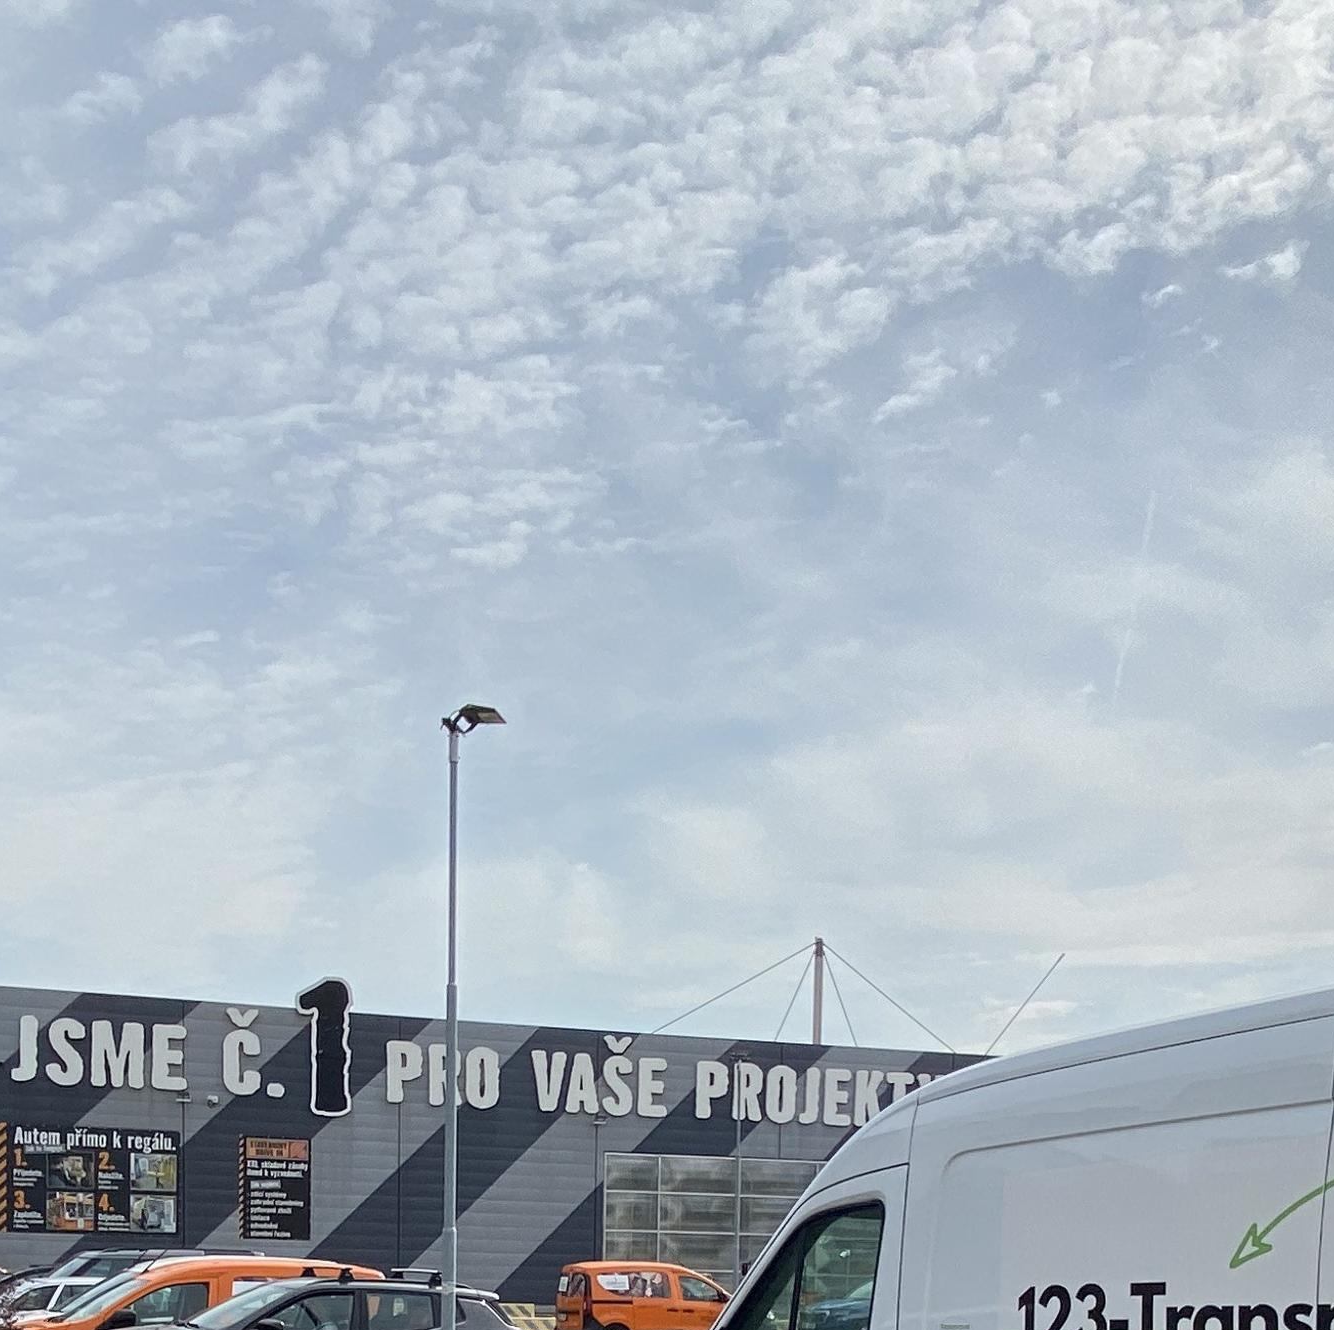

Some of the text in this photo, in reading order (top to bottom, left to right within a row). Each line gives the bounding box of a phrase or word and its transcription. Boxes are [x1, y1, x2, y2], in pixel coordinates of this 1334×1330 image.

[11, 1014, 189, 1092] JSME
[386, 1039, 502, 1110] PRO
[530, 1034, 669, 1119] VAŠE
[695, 1059, 948, 1128] PROJEKT
[14, 1127, 177, 1153] Autem přímo k regálu.
[98, 1152, 116, 1171] 2.
[13, 1190, 31, 1209] 3.
[98, 1193, 115, 1212] 4.
